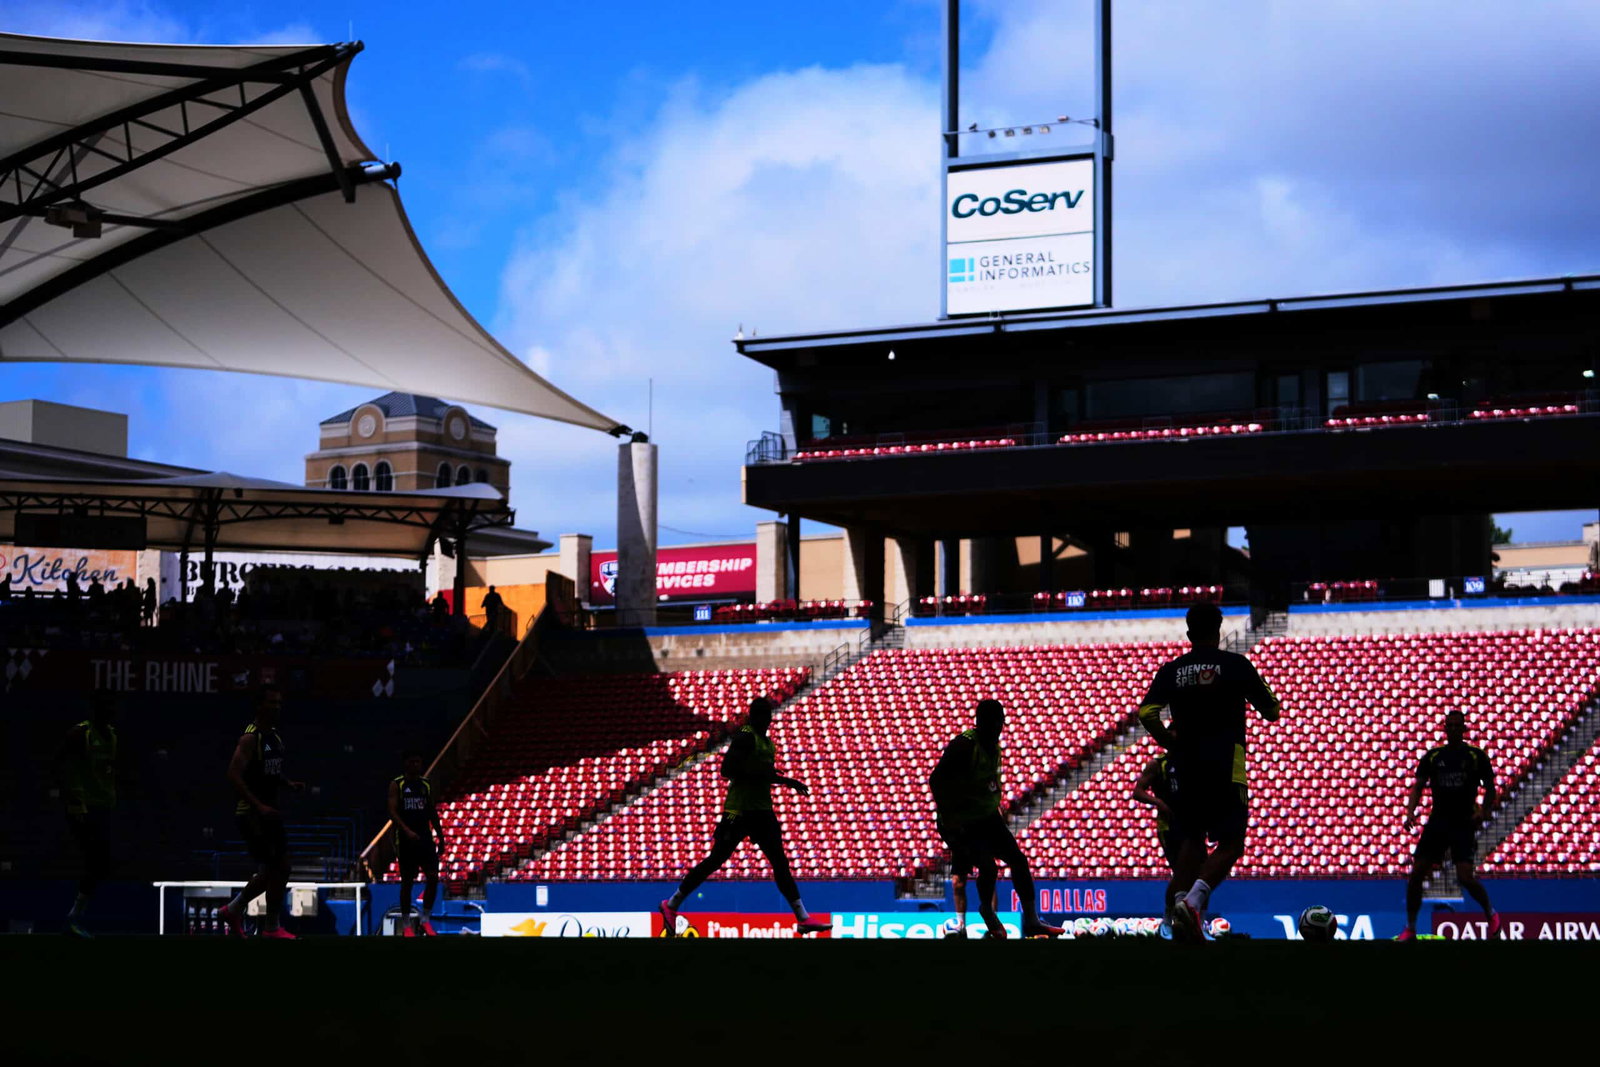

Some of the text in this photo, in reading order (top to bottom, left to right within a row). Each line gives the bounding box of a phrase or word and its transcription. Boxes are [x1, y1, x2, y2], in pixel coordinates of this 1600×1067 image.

[952, 189, 1085, 219] CoServ
[979, 251, 1056, 268] GENERAL
[979, 261, 1091, 282] INFORMATICS
[656, 557, 753, 575] MBERSHIP
[89, 659, 219, 693] THE RHINE
[1040, 888, 1107, 913] DALLAS
[1273, 914, 1375, 940] VSA
